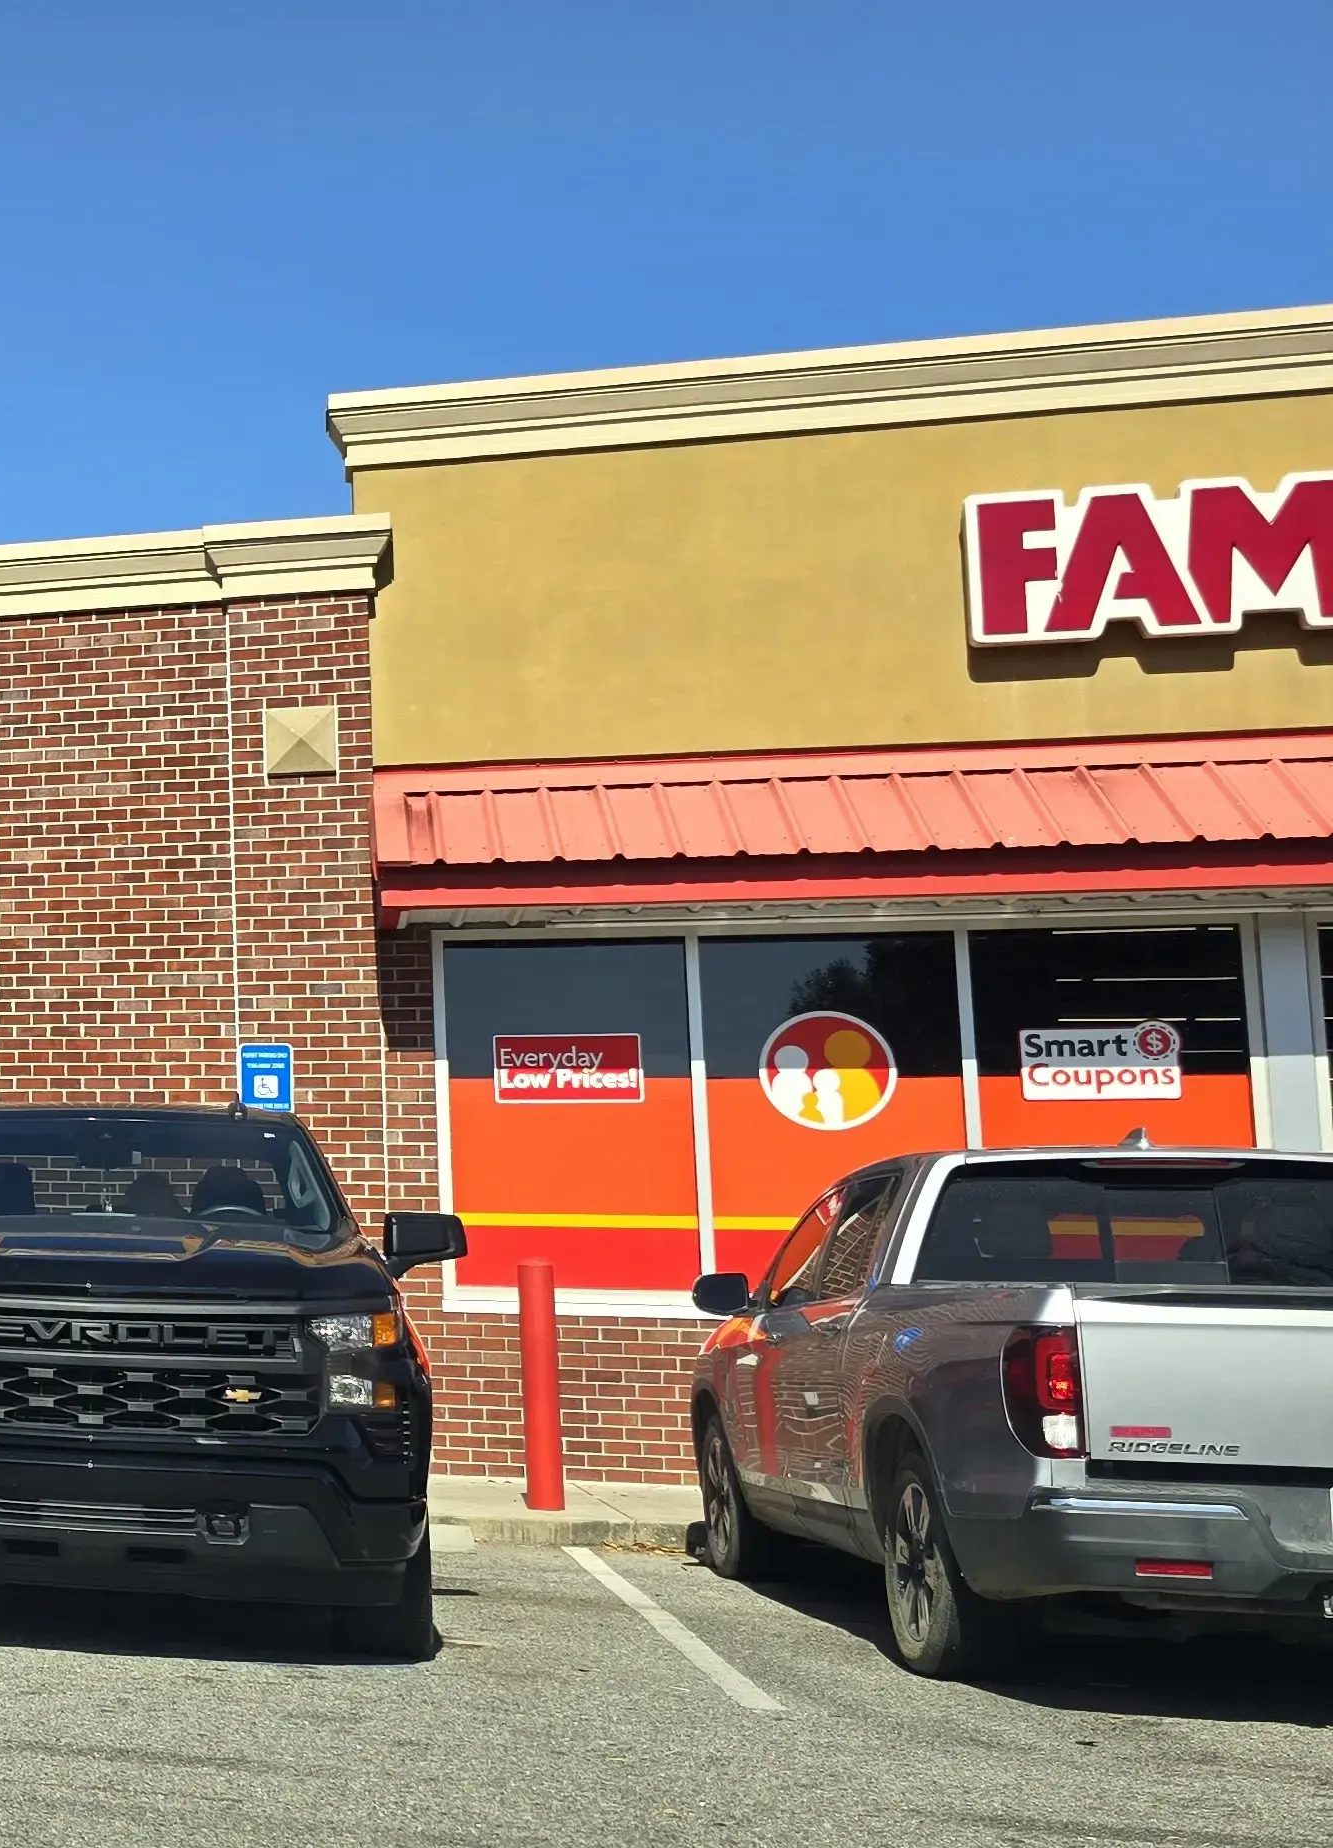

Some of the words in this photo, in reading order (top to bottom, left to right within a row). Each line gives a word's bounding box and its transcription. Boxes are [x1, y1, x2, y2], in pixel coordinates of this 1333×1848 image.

[1024, 1033, 1128, 1058] Smart
[499, 1045, 604, 1074] Everyday
[499, 1068, 551, 1089] Low
[556, 1067, 638, 1089] Prices!
[1028, 1063, 1175, 1094] Coupons
[1108, 1441, 1241, 1457] RIDGELINE
